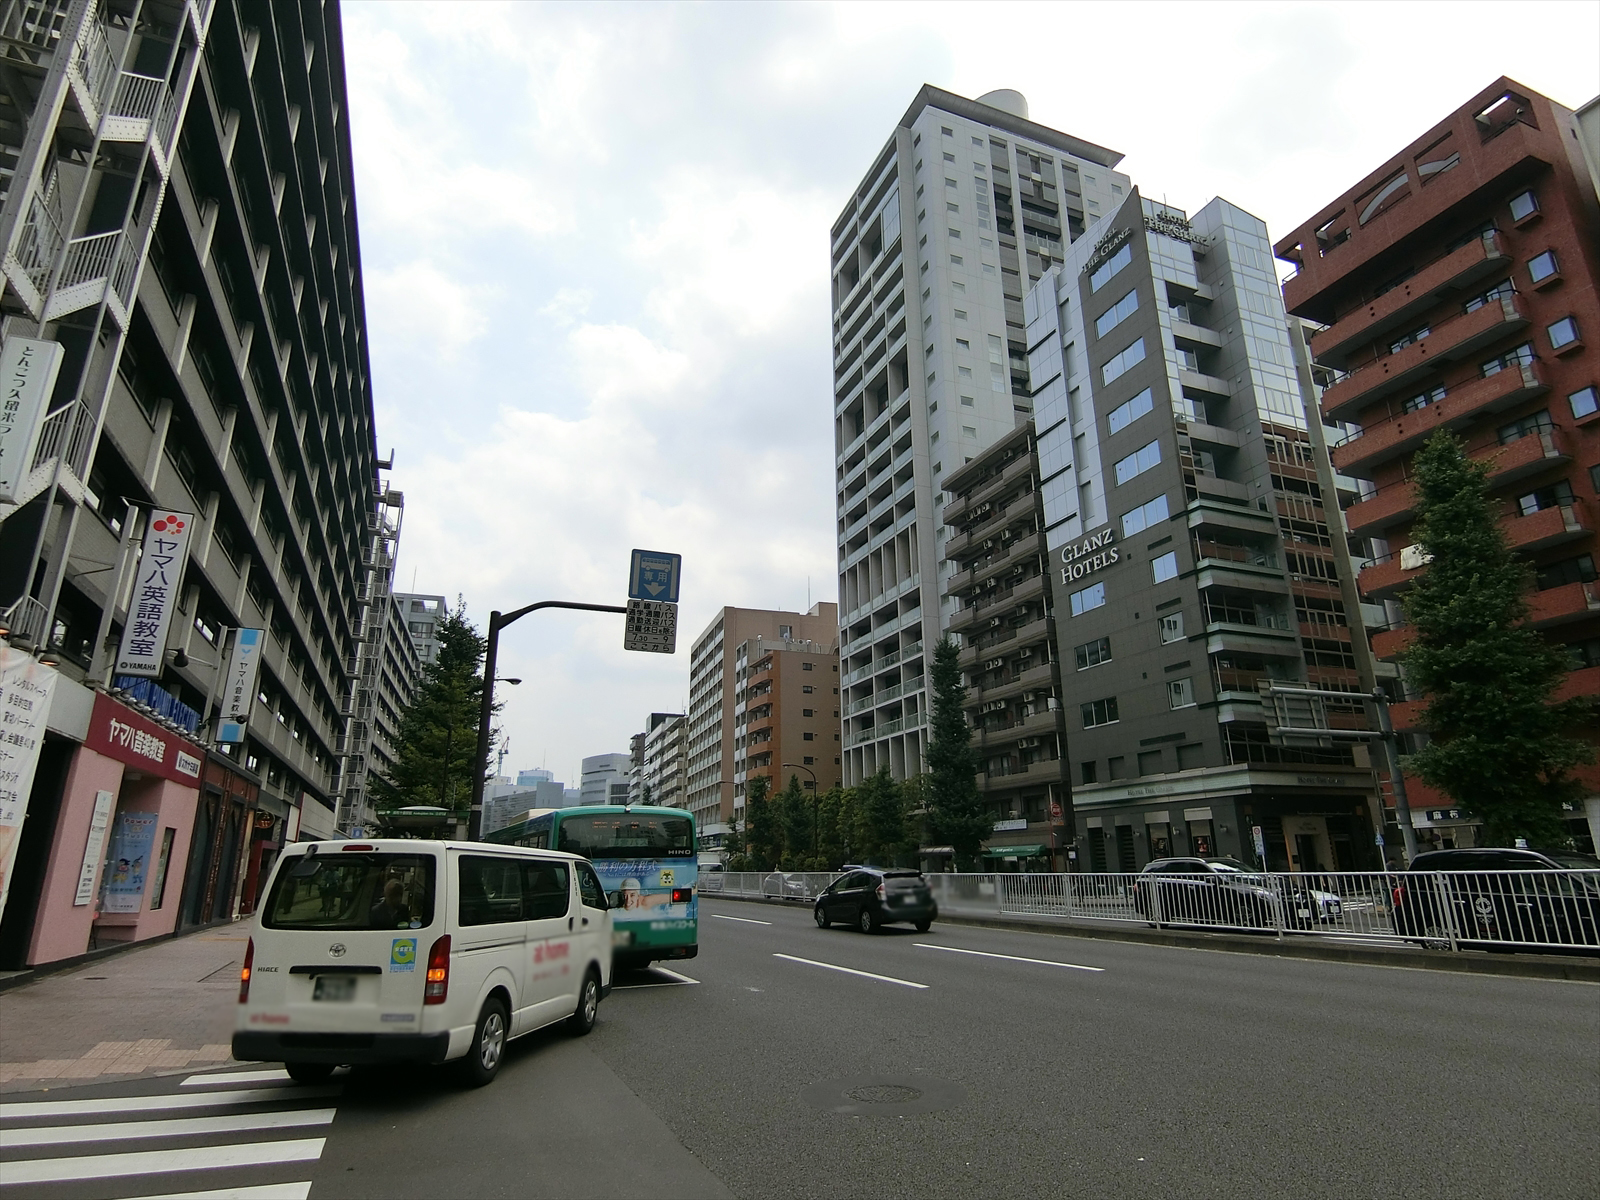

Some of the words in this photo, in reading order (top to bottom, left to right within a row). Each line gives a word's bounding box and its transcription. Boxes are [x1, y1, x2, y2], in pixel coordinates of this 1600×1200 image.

[1100, 226, 1131, 256] GLANZ
[1061, 528, 1113, 563] GLANZ
[643, 571, 668, 583] 専用
[1060, 547, 1119, 585] HOTELS
[128, 538, 178, 657] ヤマハ英語教室
[630, 643, 670, 651] ここから
[129, 662, 156, 671] YAMAHA
[109, 718, 166, 763] ヤマハ音楽教室
[599, 860, 658, 872] 勝利の方程式
